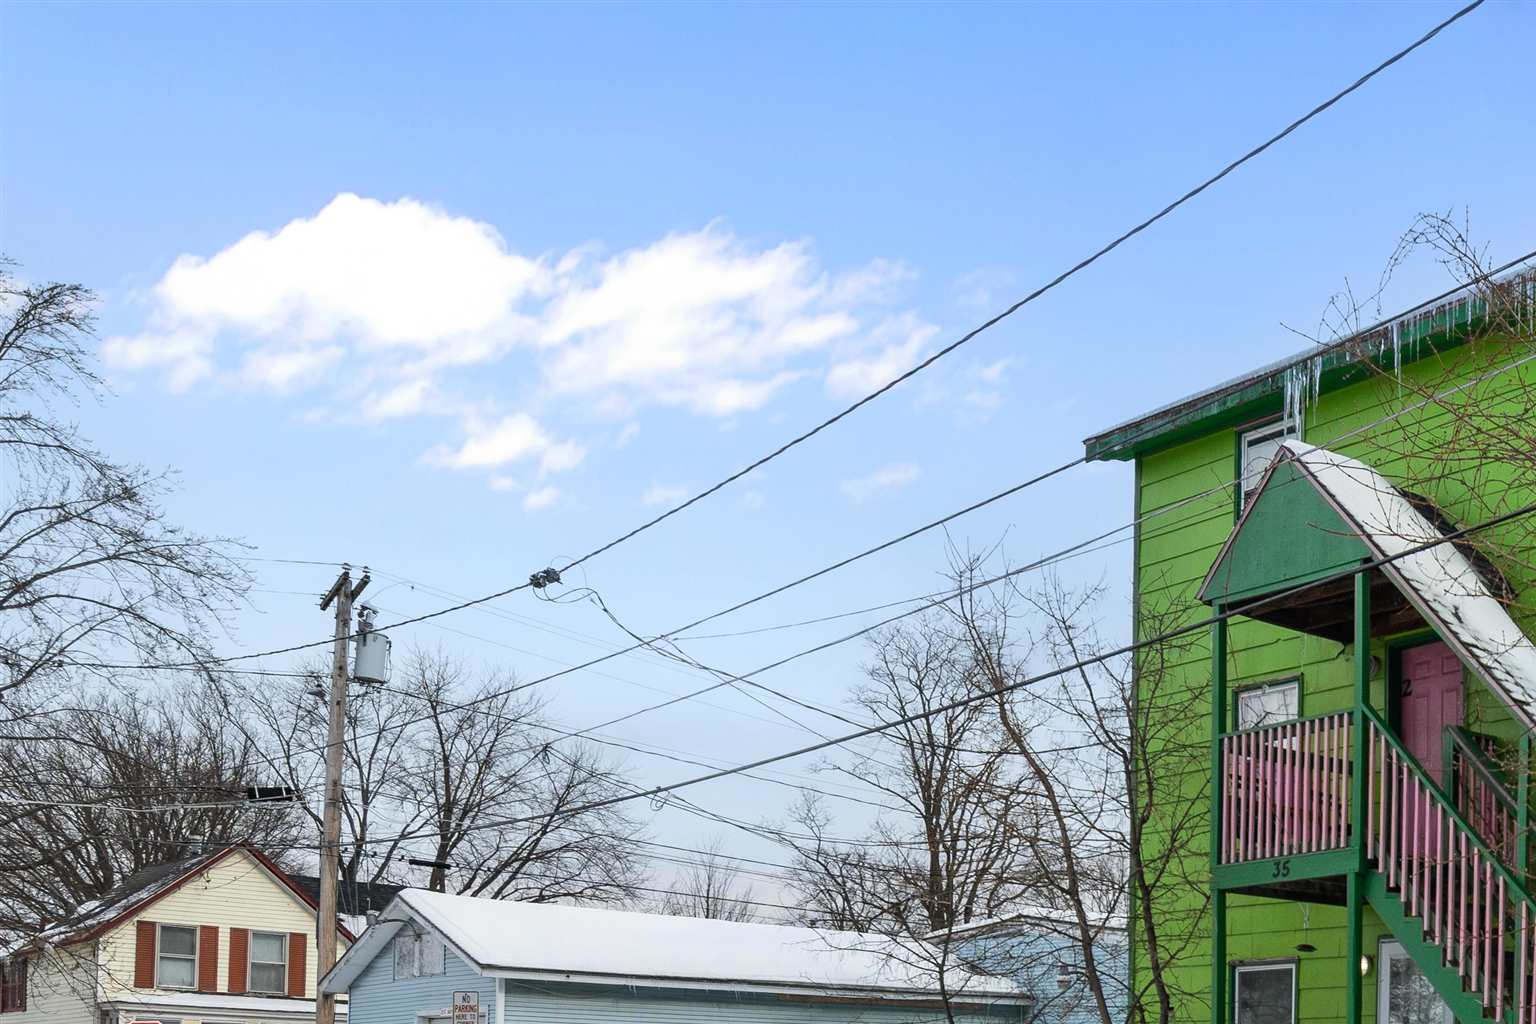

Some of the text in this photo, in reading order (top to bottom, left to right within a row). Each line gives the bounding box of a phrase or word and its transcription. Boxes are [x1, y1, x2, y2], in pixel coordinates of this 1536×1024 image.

[1272, 860, 1290, 878] 35
[462, 995, 471, 1003] NO
[455, 1004, 477, 1013] PARKING
